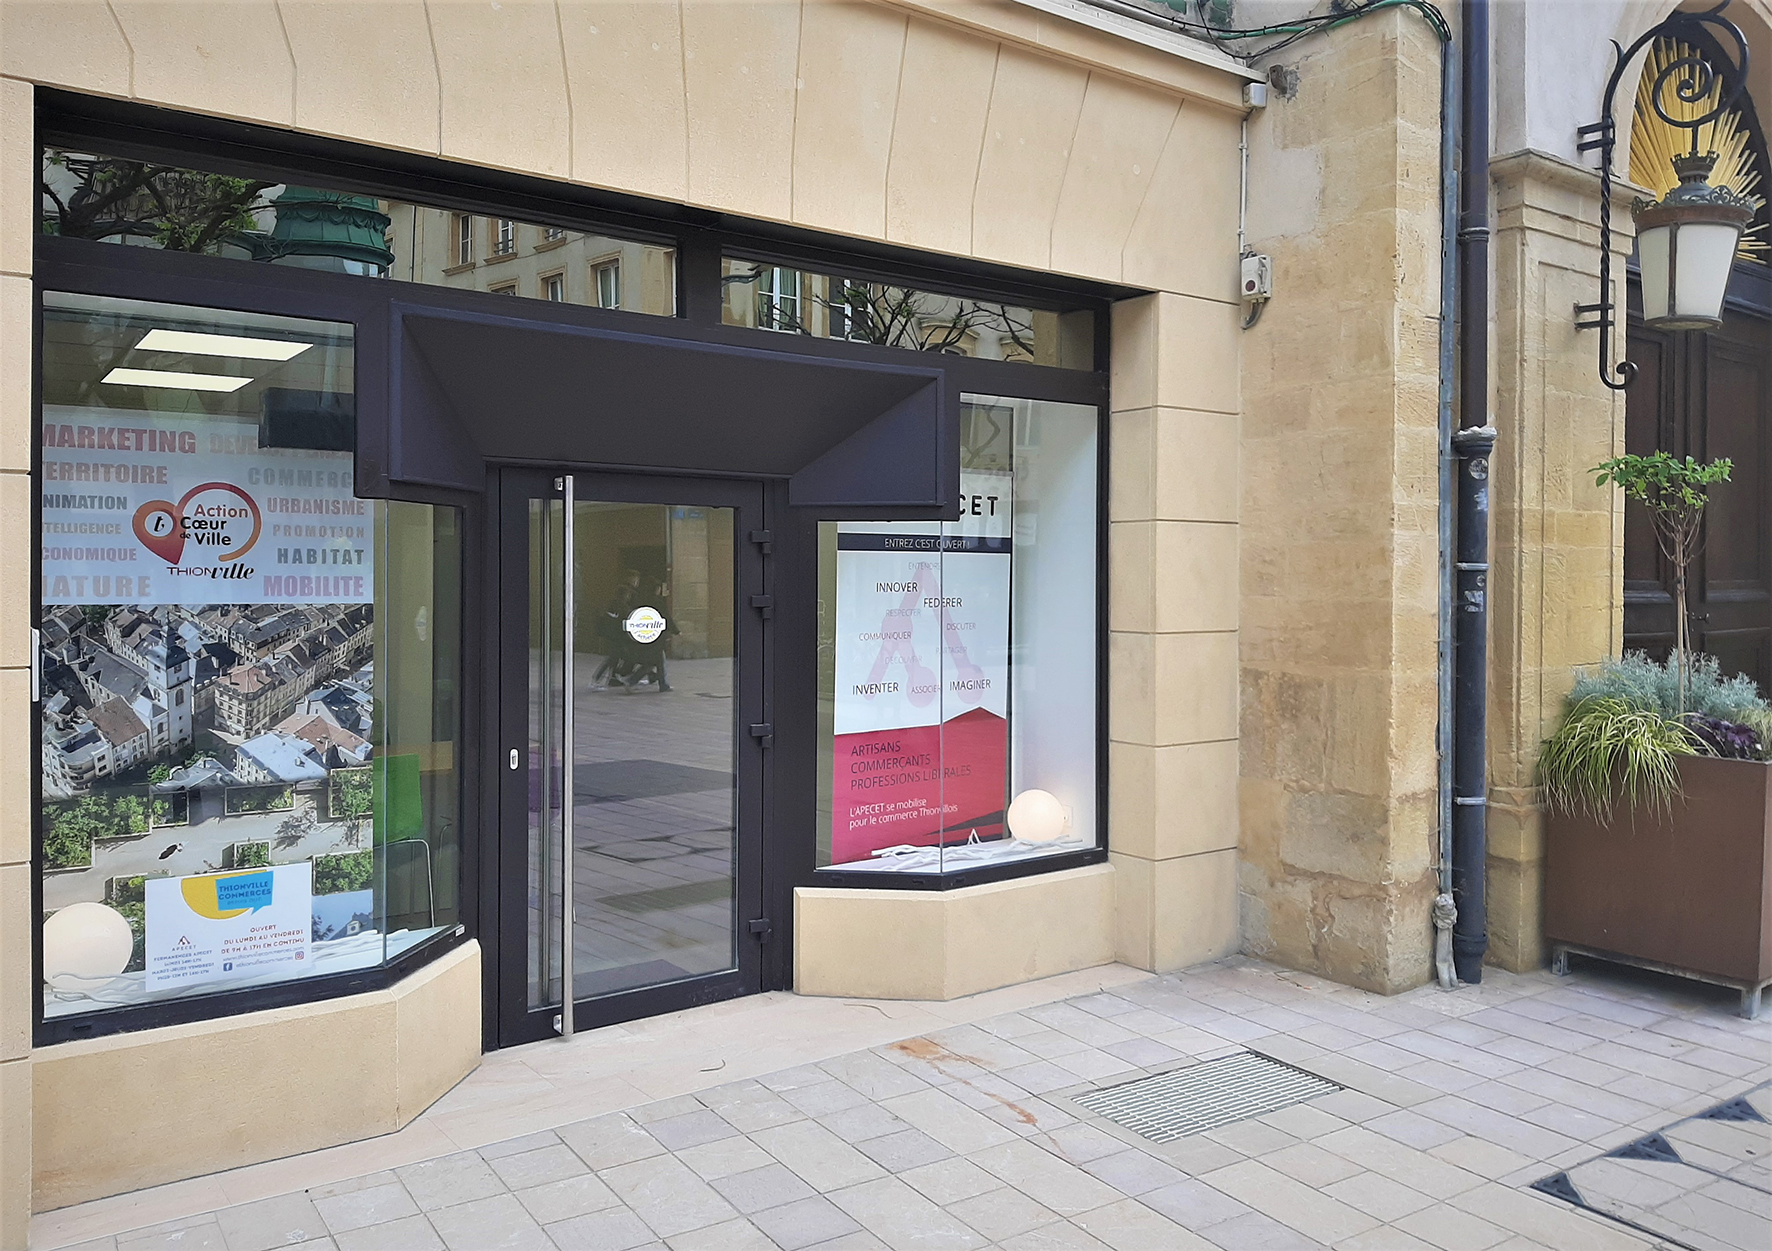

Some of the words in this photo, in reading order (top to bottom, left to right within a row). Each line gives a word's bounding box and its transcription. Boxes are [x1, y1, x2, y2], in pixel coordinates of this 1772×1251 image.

[42, 461, 168, 484] ERRITOIRE
[194, 503, 249, 518] Action
[267, 497, 364, 516] URBANISME
[43, 522, 121, 535] TELLIGENCE
[180, 516, 228, 530] Cœur
[273, 524, 365, 538] PROMOTION
[180, 531, 191, 539] de
[195, 532, 232, 546] Ville
[885, 538, 913, 548] ENTREZ
[915, 538, 935, 549] C'EST
[277, 547, 364, 565] HABITAT
[166, 562, 254, 580] THIONville
[263, 575, 364, 597] MOBILITE
[876, 582, 918, 593] INNOVER
[923, 597, 963, 608] FEDERER
[886, 609, 921, 617] RESPECTER
[946, 622, 976, 631] DISCUTER
[859, 631, 912, 641] COMMUNIQUER
[936, 646, 967, 654] PRTAGER
[852, 682, 899, 695] INVENTER
[950, 679, 991, 691] IMAGINER
[851, 741, 901, 757] ARTISANS
[851, 754, 931, 773] COMMERÇANTS
[851, 770, 921, 791] PROFESSIONS
[850, 802, 885, 817] L'APECET
[886, 803, 895, 811] se
[896, 798, 927, 810] mobilise
[849, 817, 868, 831] pour
[869, 815, 877, 825] le
[878, 810, 918, 823] commerce
[219, 881, 268, 892] THIONVILLE
[218, 888, 272, 900] COMMERCES
[250, 924, 277, 933] OUVERT
[235, 936, 257, 944] LUNDI
[270, 929, 304, 938] VENDREDI
[273, 938, 305, 947] CONTINU
